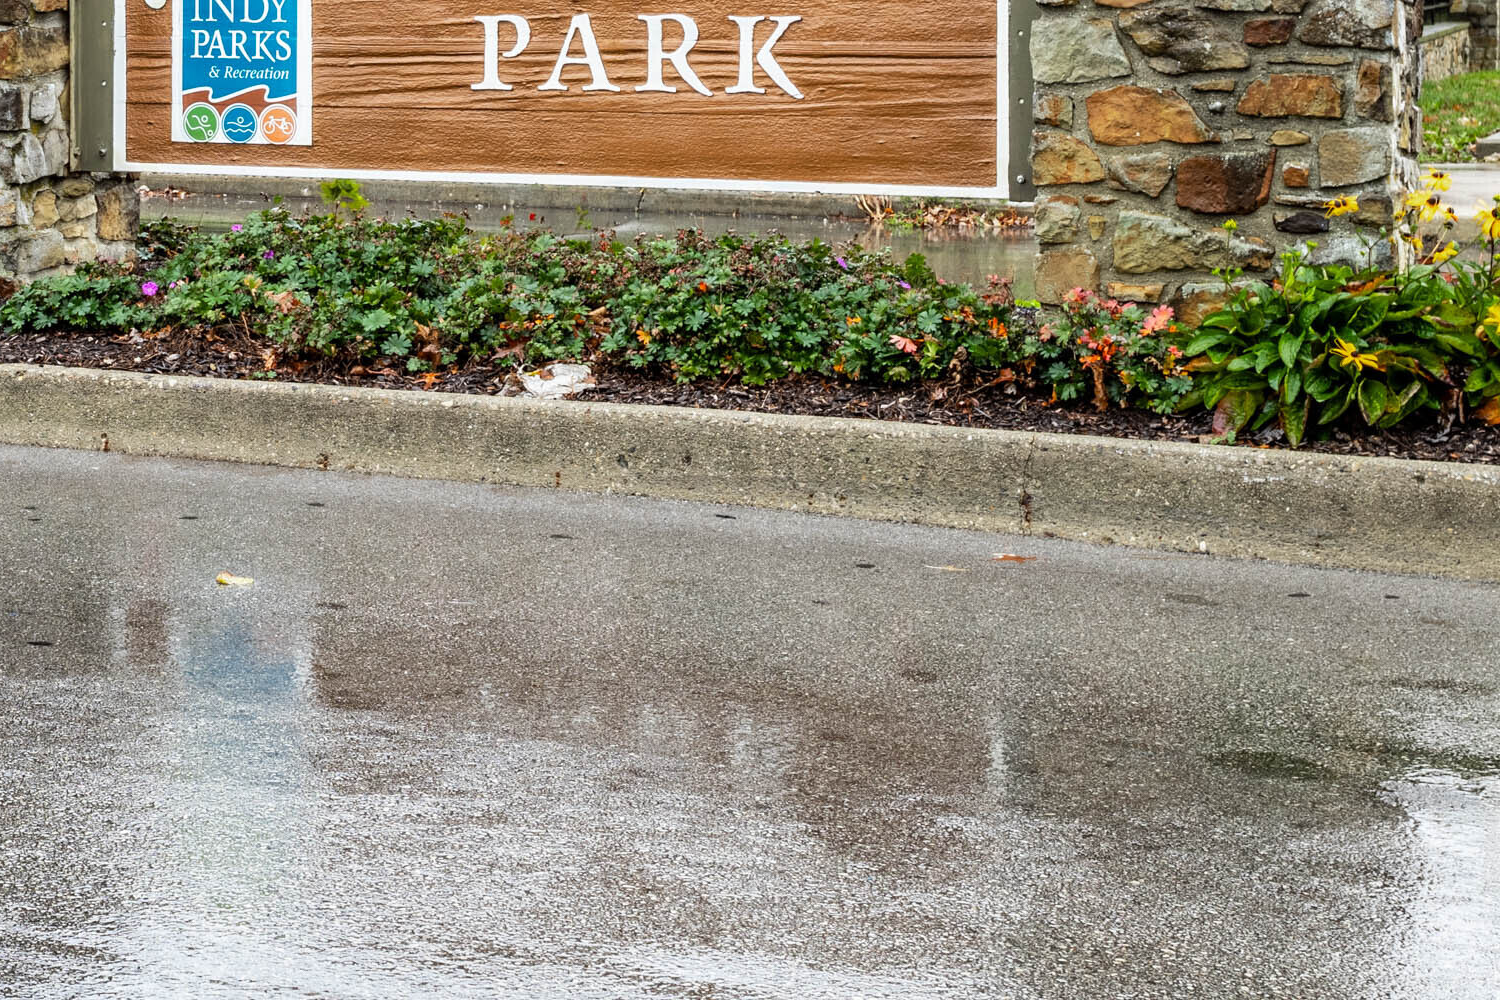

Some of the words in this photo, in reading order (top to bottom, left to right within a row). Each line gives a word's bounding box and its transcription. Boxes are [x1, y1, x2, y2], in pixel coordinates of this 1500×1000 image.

[190, 29, 292, 63] PARKS
[470, 13, 805, 100] PARK
[208, 65, 221, 79] &
[224, 66, 290, 80] Recreation
